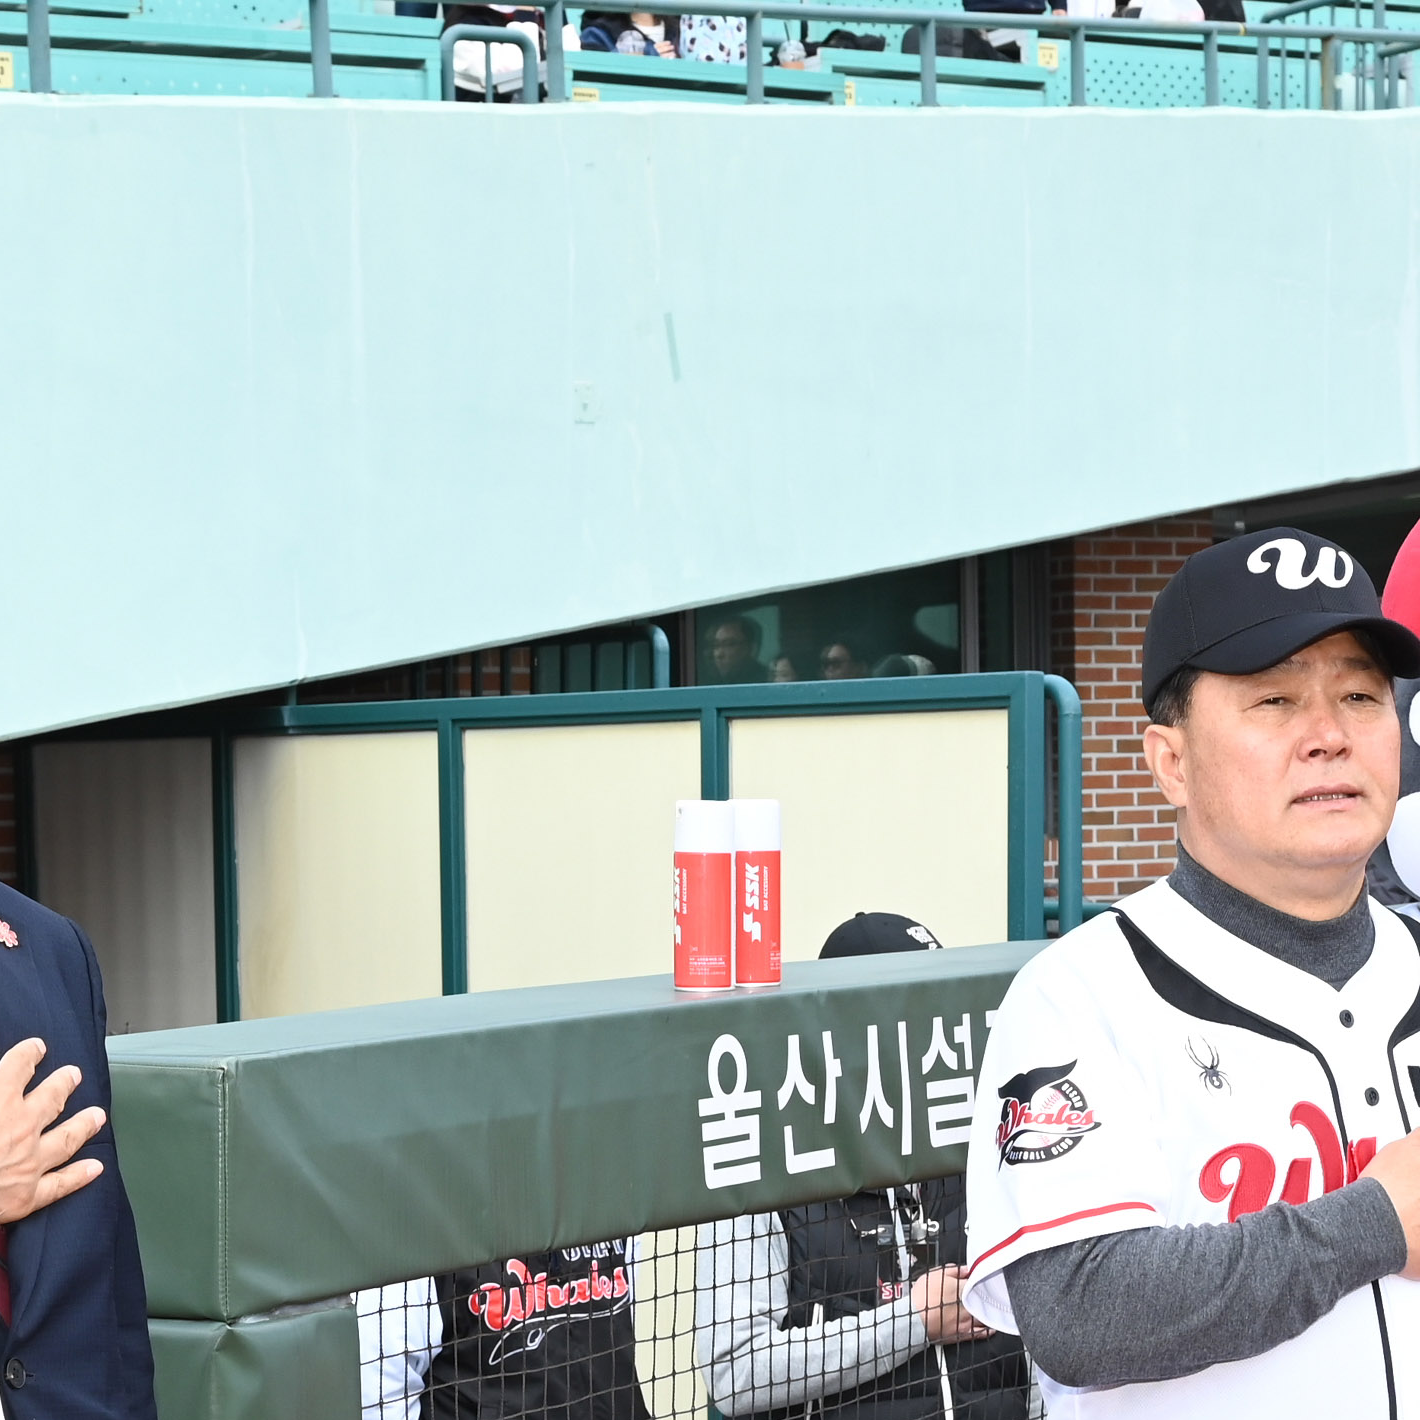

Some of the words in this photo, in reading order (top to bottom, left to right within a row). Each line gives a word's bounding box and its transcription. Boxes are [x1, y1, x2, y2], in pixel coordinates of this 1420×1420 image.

[745, 862, 760, 911] SSK
[995, 1098, 1096, 1151] Whales
[467, 1258, 630, 1332] Whales
